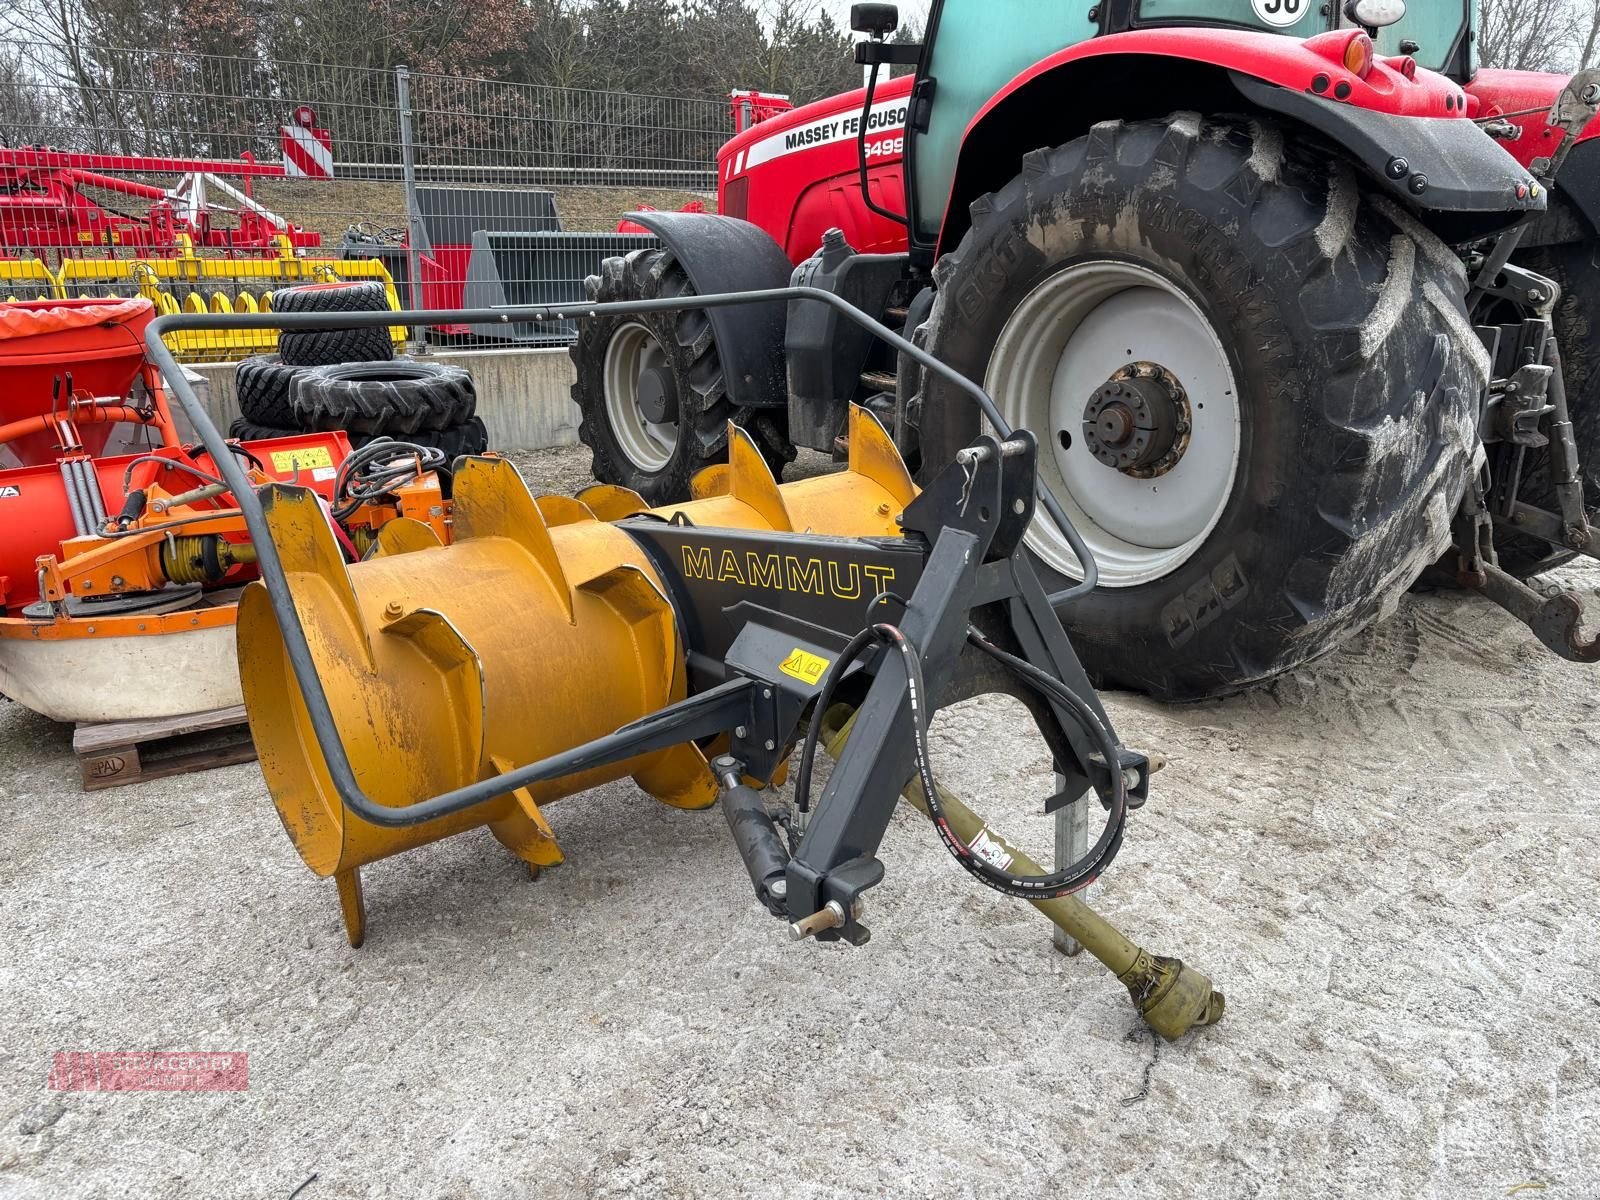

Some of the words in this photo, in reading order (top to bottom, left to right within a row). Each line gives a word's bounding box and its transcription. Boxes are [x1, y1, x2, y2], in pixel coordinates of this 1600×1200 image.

[785, 122, 838, 150] MASSEY
[842, 107, 907, 135] FEGUSO
[681, 545, 895, 603] MAMMUT
